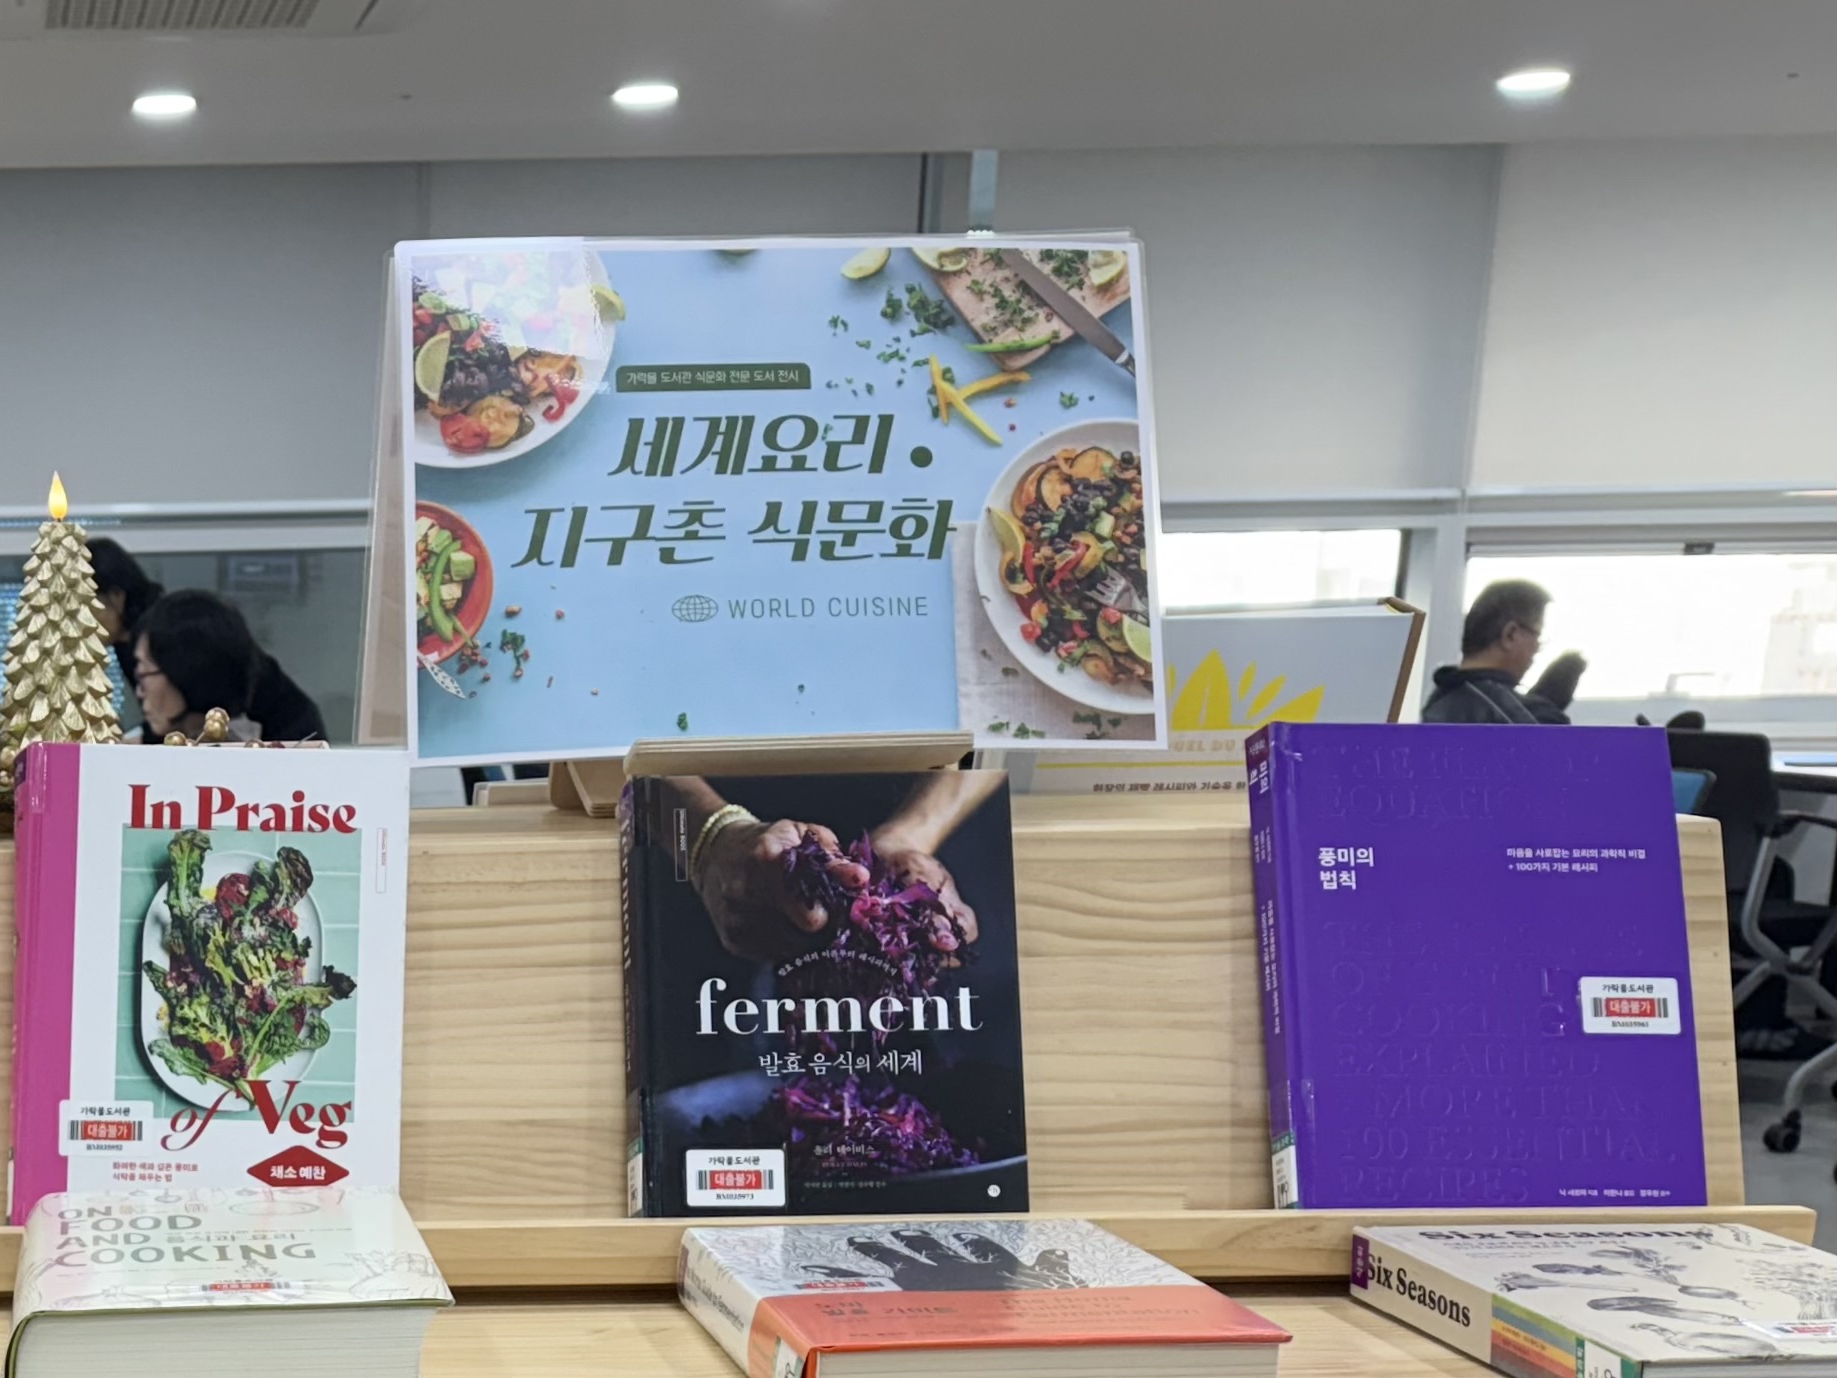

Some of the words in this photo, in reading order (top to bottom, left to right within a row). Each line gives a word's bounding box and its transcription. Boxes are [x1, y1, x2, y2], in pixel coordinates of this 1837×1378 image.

[626, 372, 657, 387] 가락몰
[661, 372, 691, 386] 도서관
[695, 371, 726, 385] 식문화
[729, 371, 750, 384] 전문
[754, 370, 775, 384] 도서
[778, 369, 800, 383] 전시
[608, 414, 894, 476] 세계요리
[511, 502, 726, 568] 지구촌
[747, 498, 958, 562] 식문화
[728, 597, 815, 618] WORLD
[828, 595, 928, 617] CUISINE
[128, 784, 182, 830] In
[195, 786, 357, 833] Praise
[1318, 847, 1374, 866] 풍미의
[1535, 848, 1569, 859] 사로잡는
[1600, 848, 1626, 859] 과학적
[1628, 849, 1646, 860] 비결
[1516, 862, 1550, 872] 100가지
[1552, 862, 1570, 872] 기본
[1320, 870, 1357, 890] 법칙
[1602, 984, 1654, 994] 가락몰도서관
[696, 977, 983, 1035] ferment
[1610, 1001, 1652, 1014] 대출불가
[759, 1052, 805, 1077] 발효
[808, 1051, 870, 1076] 음식의
[876, 1049, 922, 1075] 세계
[80, 1106, 130, 1116] 가락몰도서관
[161, 1084, 244, 1150] of
[243, 1080, 352, 1149] Veg
[87, 1123, 128, 1138] 대출불가
[708, 1155, 760, 1166] 가락몰도서관
[270, 1164, 296, 1180] 채소
[299, 1165, 325, 1180] 예찬
[714, 1173, 756, 1186] 대출불가
[57, 1206, 112, 1219] ON
[60, 1216, 201, 1235] FOOD
[56, 1233, 151, 1249] AND
[166, 1234, 240, 1243] 음식과
[252, 1232, 295, 1242] 요리
[1419, 1230, 1496, 1240] Six
[55, 1244, 316, 1267] COOKING
[1366, 1254, 1393, 1290] Six
[1397, 1267, 1471, 1327] Seasons
